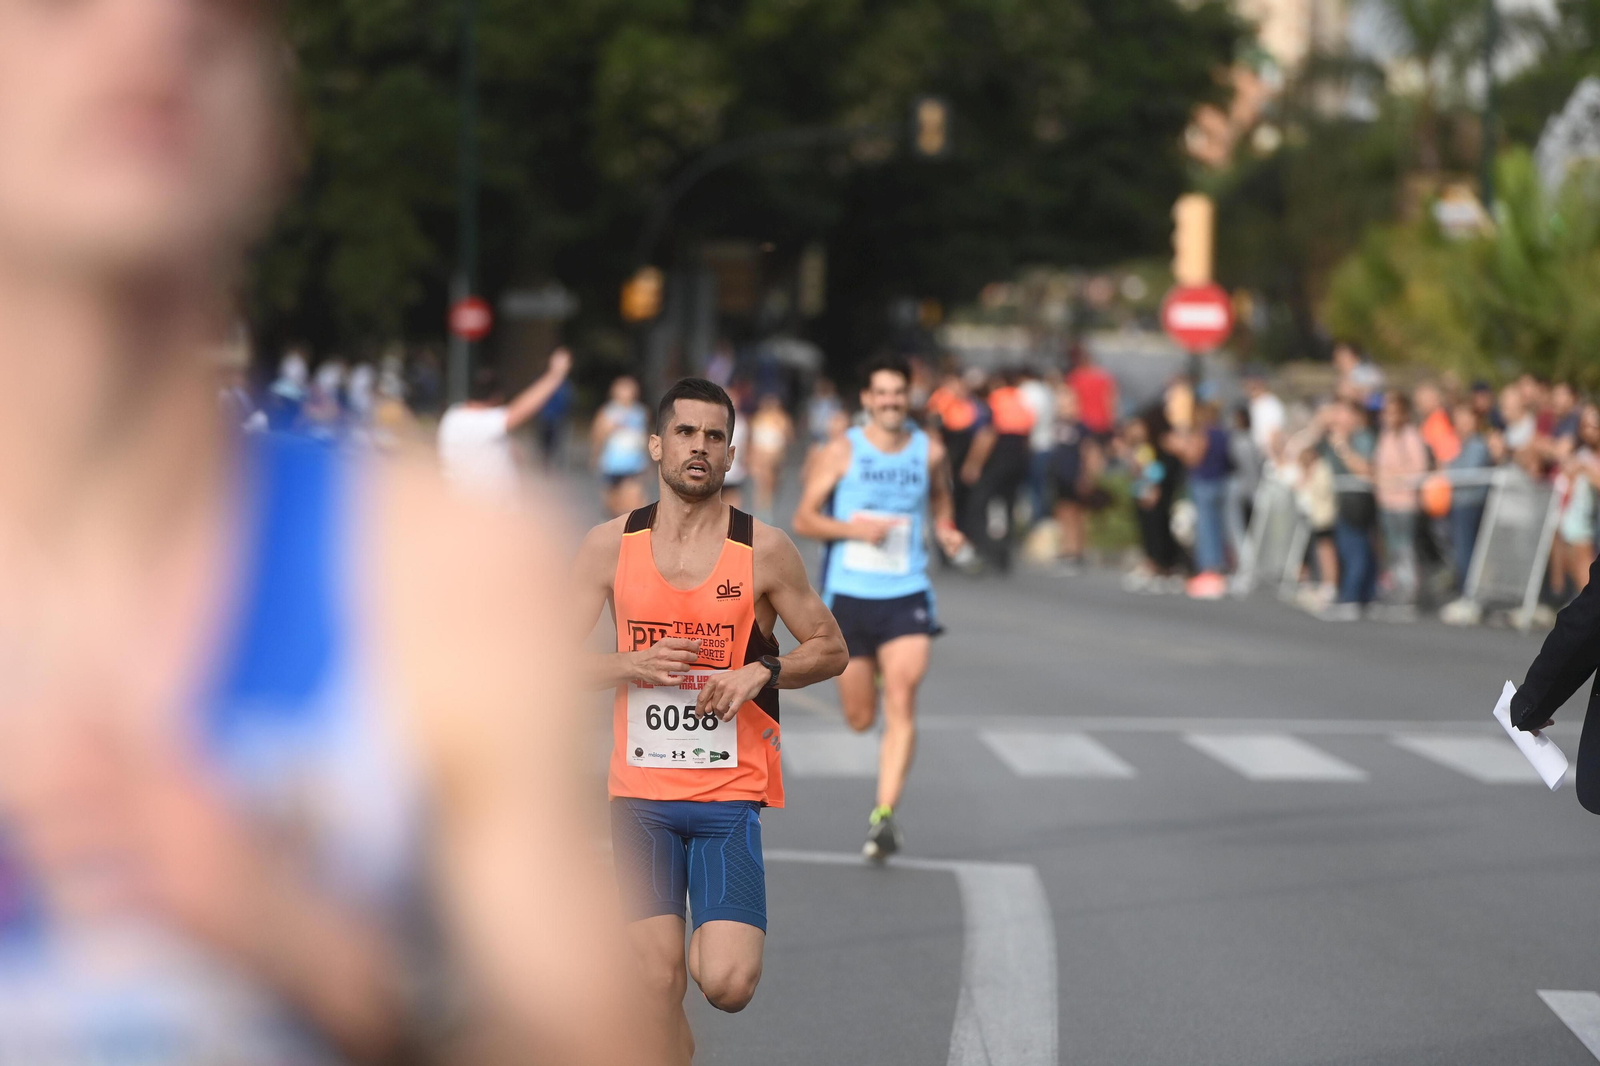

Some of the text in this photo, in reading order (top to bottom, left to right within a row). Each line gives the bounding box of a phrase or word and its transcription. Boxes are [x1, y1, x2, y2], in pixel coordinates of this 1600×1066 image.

[716, 579, 741, 598] als
[673, 621, 721, 636] TEAM
[645, 704, 719, 731] 6058
